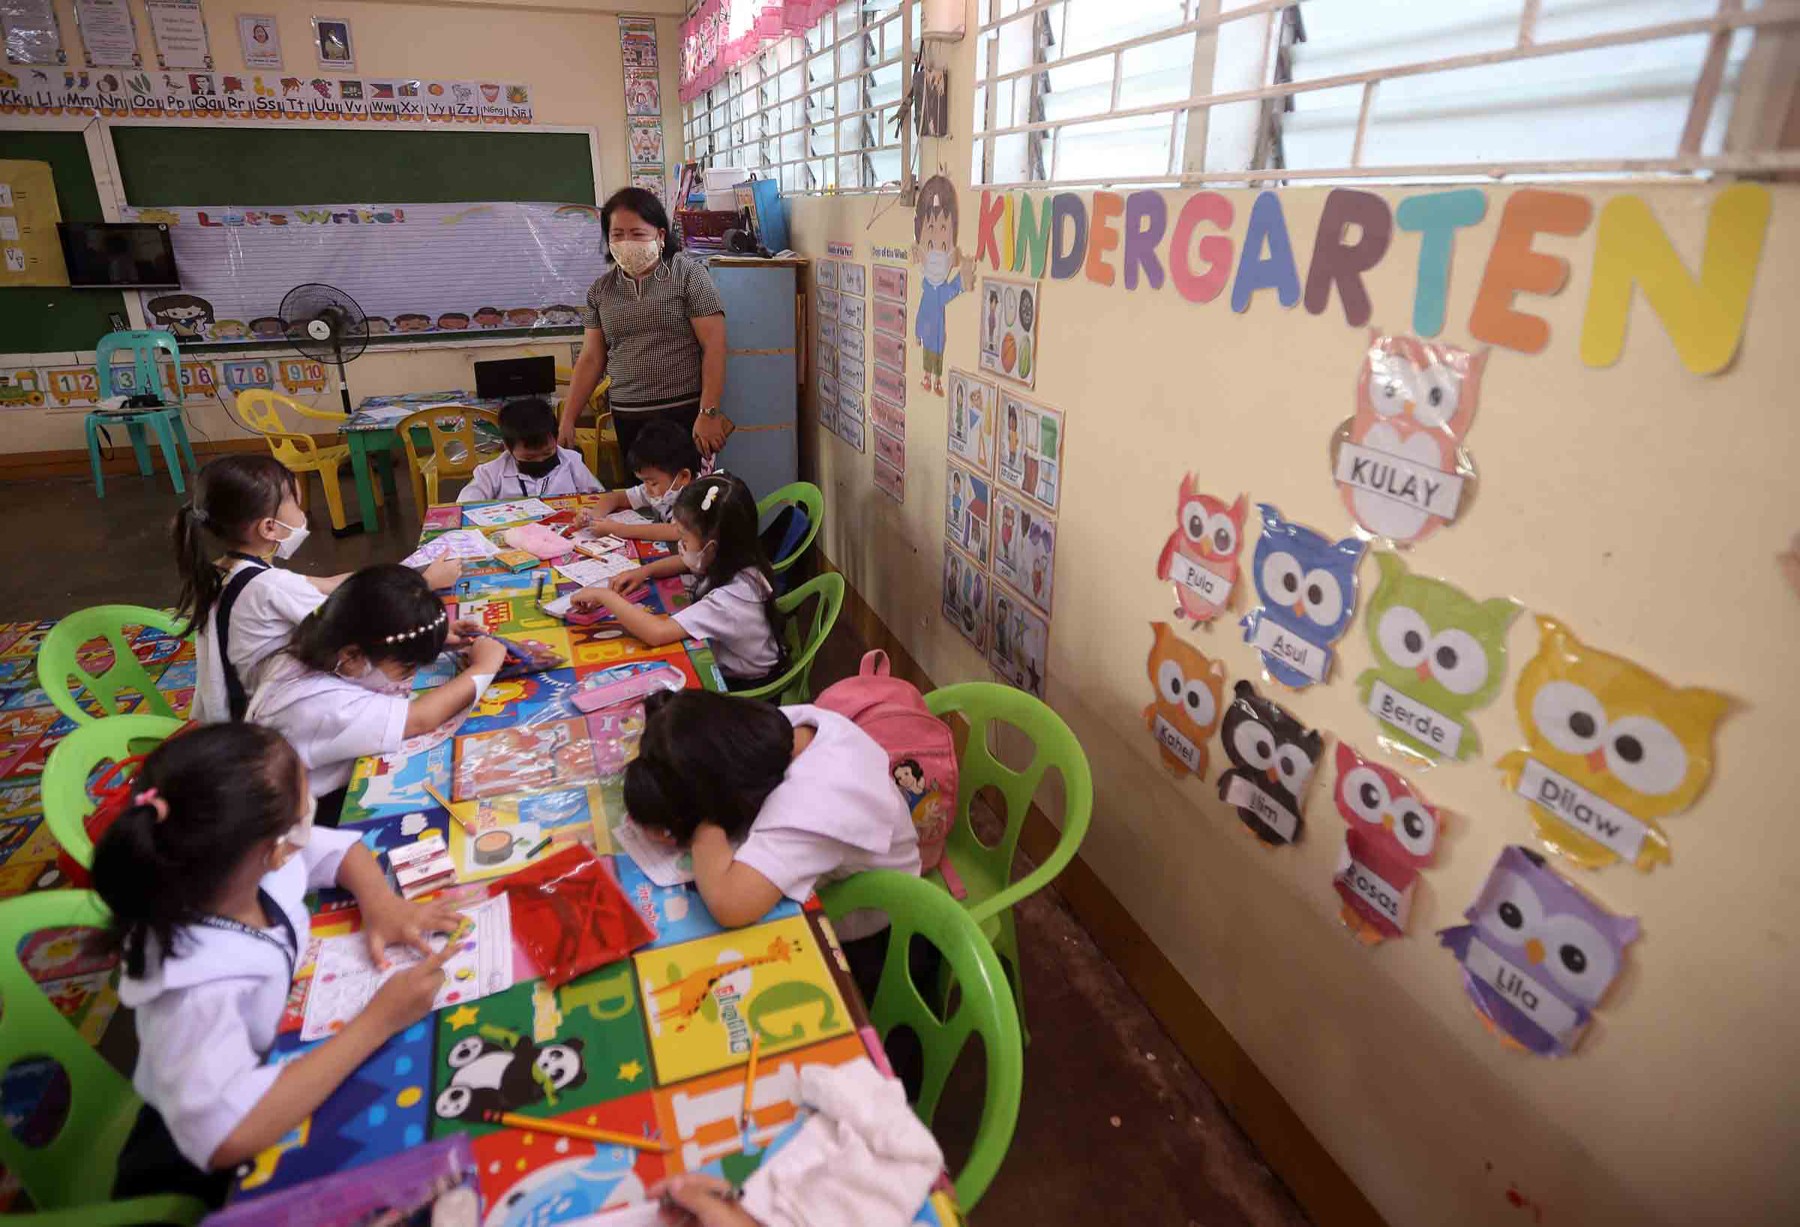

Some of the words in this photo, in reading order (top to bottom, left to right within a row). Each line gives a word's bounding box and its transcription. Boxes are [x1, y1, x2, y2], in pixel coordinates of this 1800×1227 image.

[0, 90, 23, 105] Kk
[67, 93, 95, 107] Mm
[99, 94, 124, 109] Nn
[133, 95, 156, 108] Oo
[167, 96, 185, 112] Pp
[195, 96, 218, 112] Qq
[227, 97, 245, 110] Rr
[256, 97, 276, 110] Ss
[286, 98, 305, 110] Tt
[314, 98, 336, 112] Uu
[345, 101, 362, 113] Vv
[372, 102, 396, 113] Ww
[401, 102, 419, 114] Xx
[430, 103, 446, 115] Yy
[456, 103, 475, 115] Zz
[975, 183, 1772, 376] KINDERGARTEN
[60, 373, 72, 392] 1
[80, 374, 95, 391] 2
[120, 372, 134, 388] 3
[198, 369, 211, 385] 6
[234, 367, 245, 383] 7
[253, 367, 267, 382] 8
[289, 364, 301, 380] 9
[305, 364, 321, 381] 10
[1350, 456, 1440, 507] KULAY
[1186, 566, 1215, 594] Pula
[1271, 635, 1308, 665] Asul
[1379, 694, 1446, 744] Berde
[1158, 725, 1195, 762] Kahel
[1538, 777, 1622, 838] Dilaw
[1494, 966, 1539, 1012] Lila
